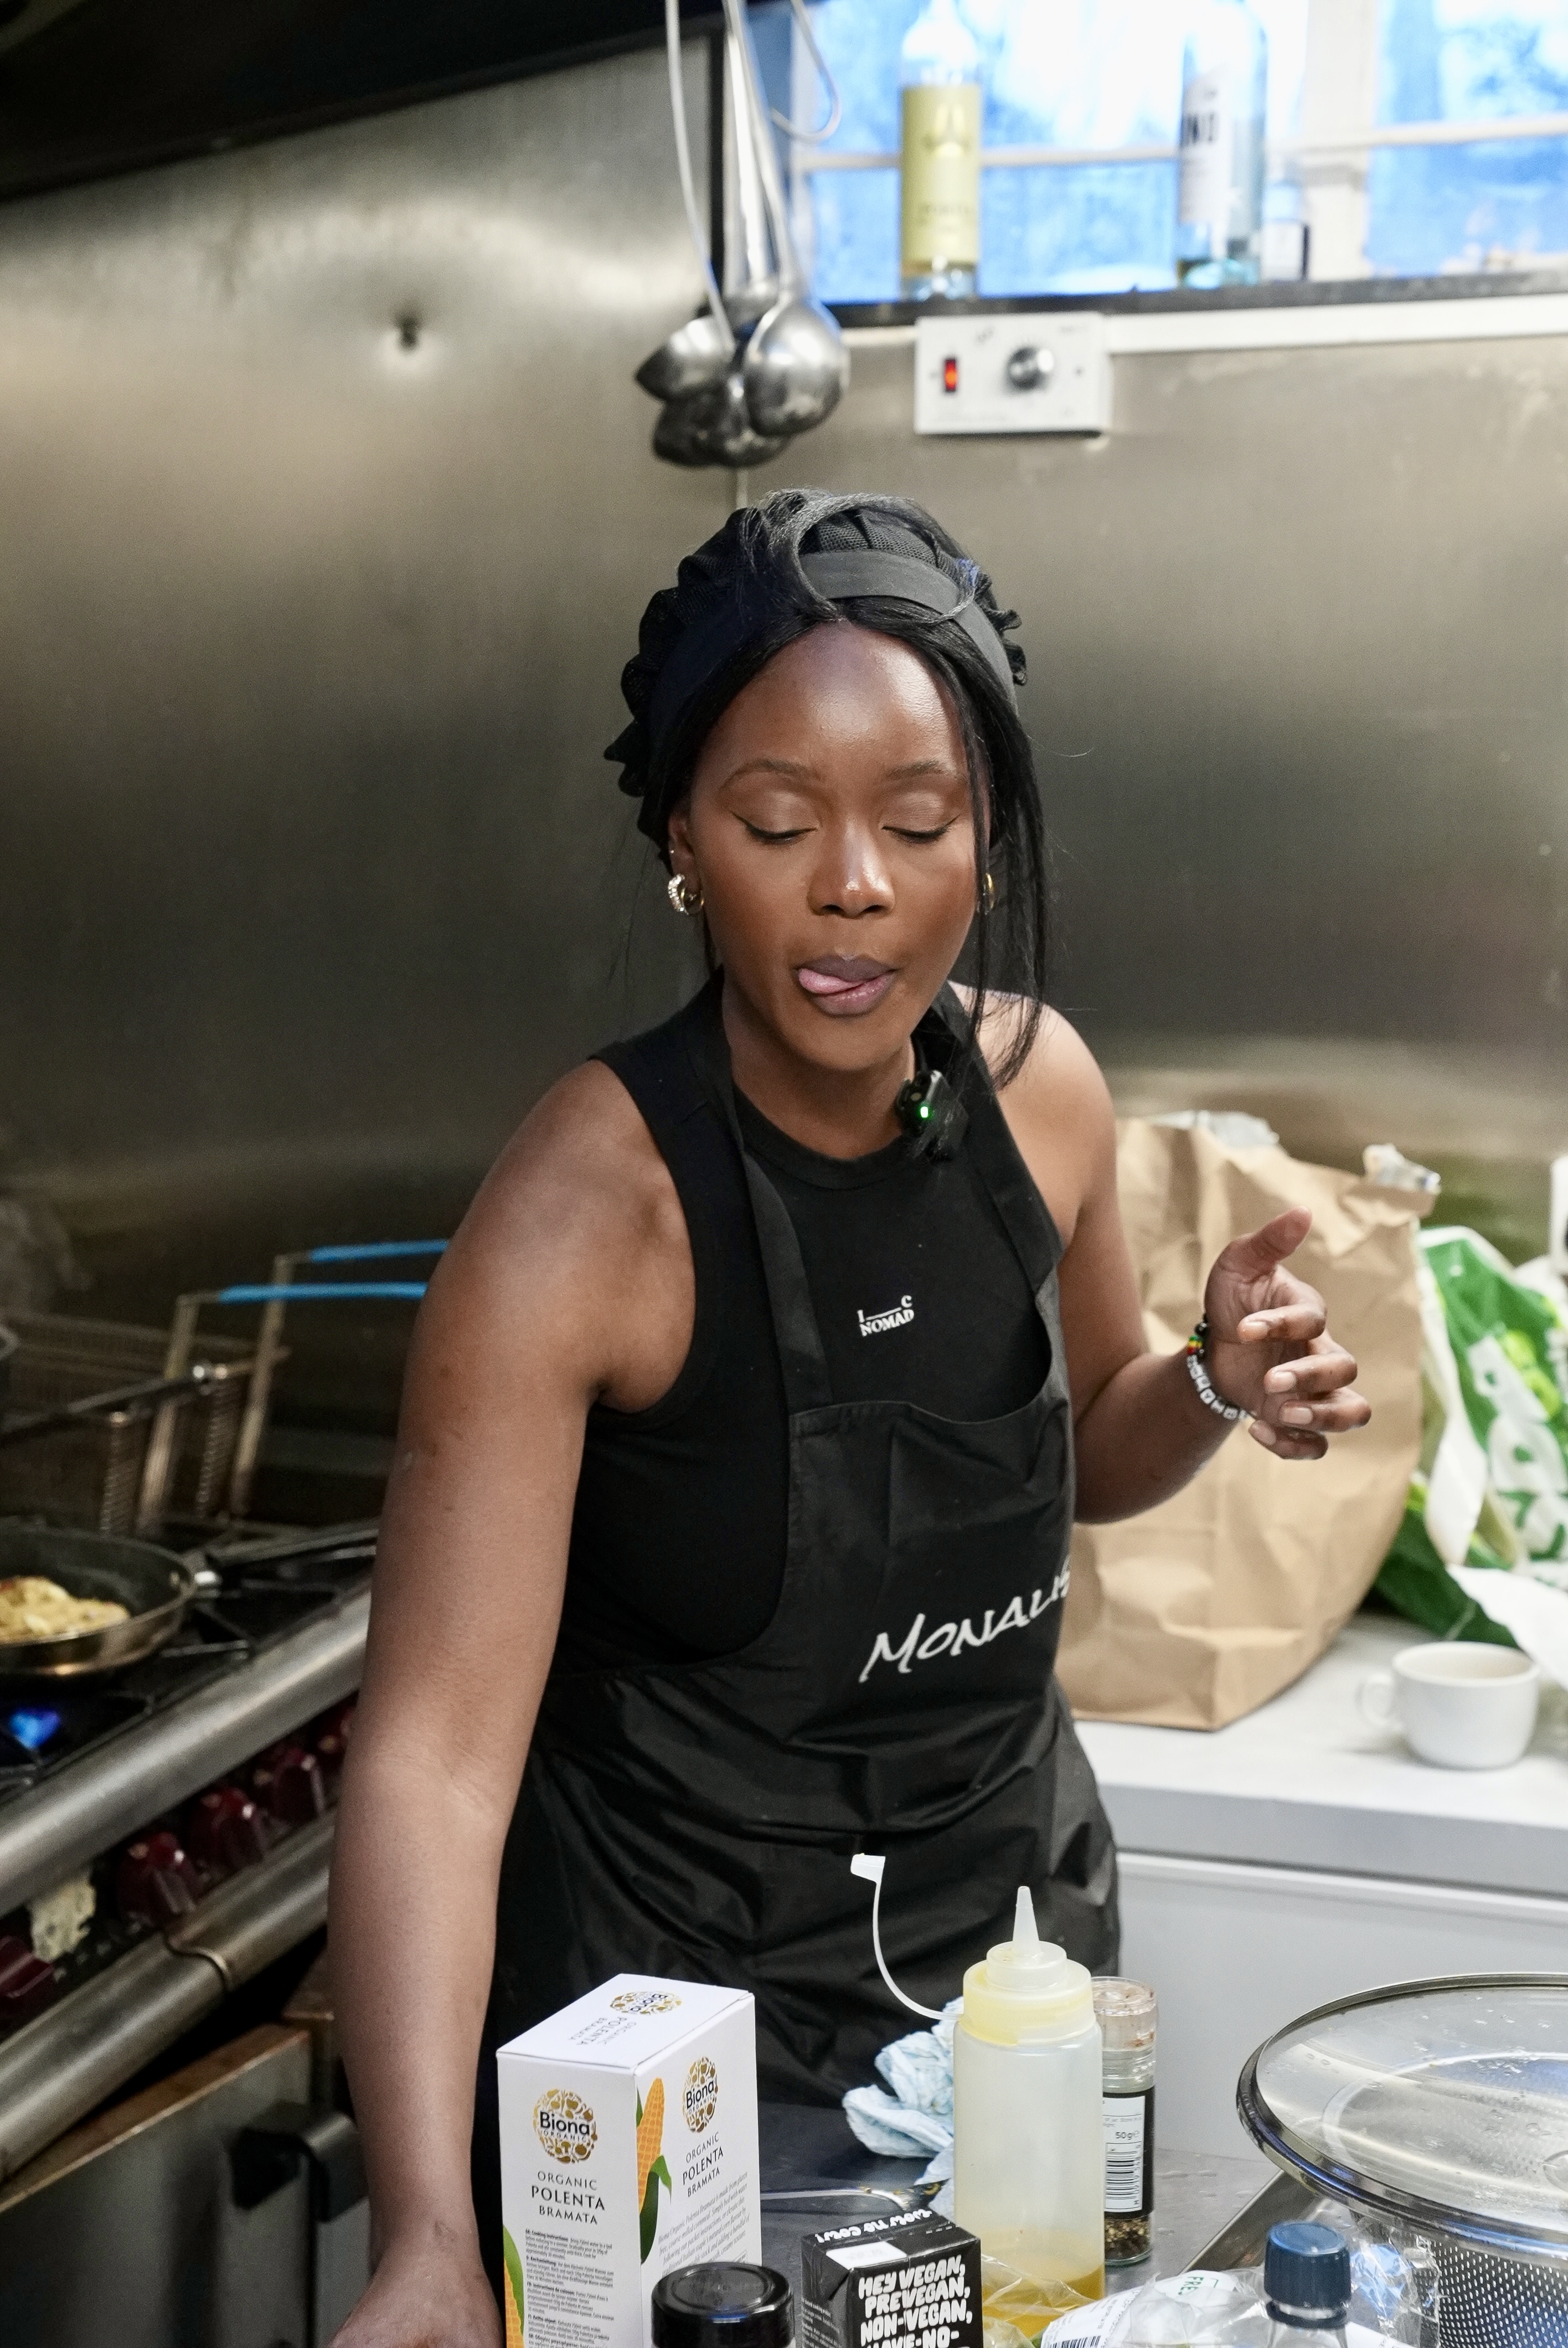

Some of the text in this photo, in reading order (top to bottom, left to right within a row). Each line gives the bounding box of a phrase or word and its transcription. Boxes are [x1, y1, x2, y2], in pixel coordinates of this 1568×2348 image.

[859, 1309, 915, 1337] NOMAD
[576, 2016, 627, 2045] POLENTA
[686, 2080, 715, 2109] Biona
[539, 2111, 590, 2136] Biona
[543, 2130, 587, 2143] ORGANIC
[685, 2131, 719, 2164] ORGANIC
[682, 2146, 724, 2185] POLENTA
[537, 2170, 597, 2191] ORGANIC
[688, 2165, 720, 2198] BRAMATA
[531, 2185, 605, 2211] POLENTA
[539, 2205, 597, 2225] BRAMATA
[858, 2254, 966, 2299] HEY VEGAN,
[1178, 2277, 1204, 2295] FRE
[864, 2275, 971, 2319] PREVEGAN,
[860, 2298, 973, 2347] NON-VEGAN,
[866, 2326, 960, 2348] E-NO-
